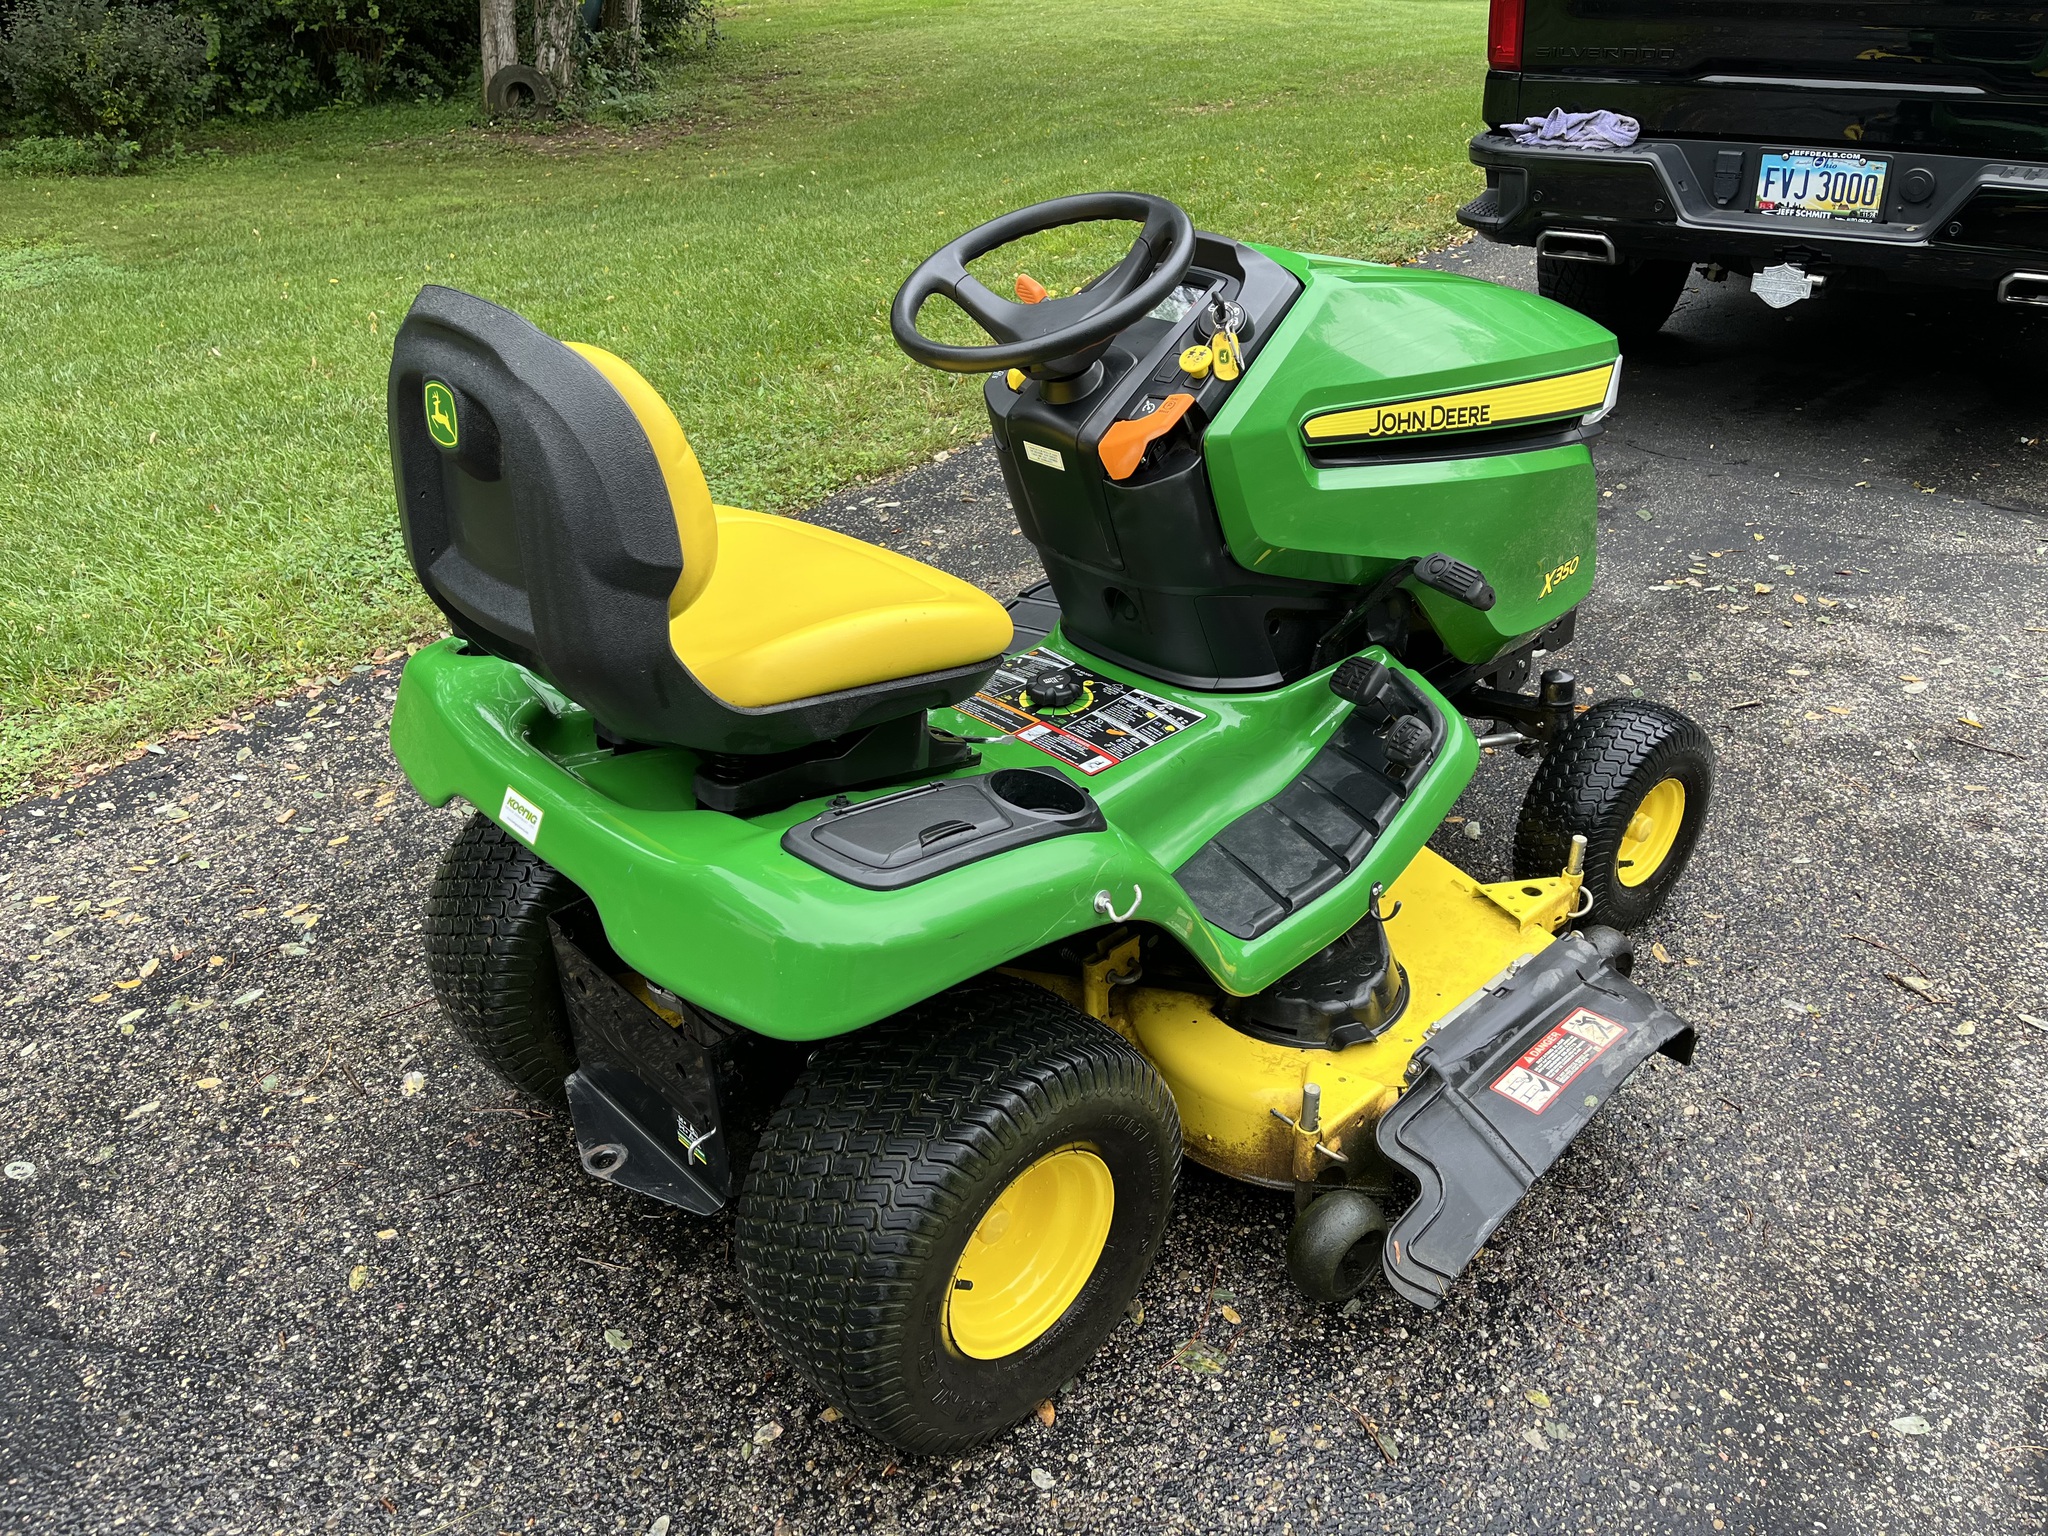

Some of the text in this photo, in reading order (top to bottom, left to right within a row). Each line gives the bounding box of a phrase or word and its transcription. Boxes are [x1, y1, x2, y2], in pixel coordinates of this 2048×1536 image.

[1535, 46, 1675, 58] SILVERADO
[1789, 149, 1861, 160] JEFFDEALS.COM
[1763, 166, 1879, 206] FVJ 3000
[1776, 208, 1795, 216] JEFF
[1795, 209, 1832, 219] SCHMITT
[1369, 404, 1491, 433] JOHN DEERE
[1537, 555, 1580, 601] X350
[1529, 1030, 1561, 1057] DANGER
